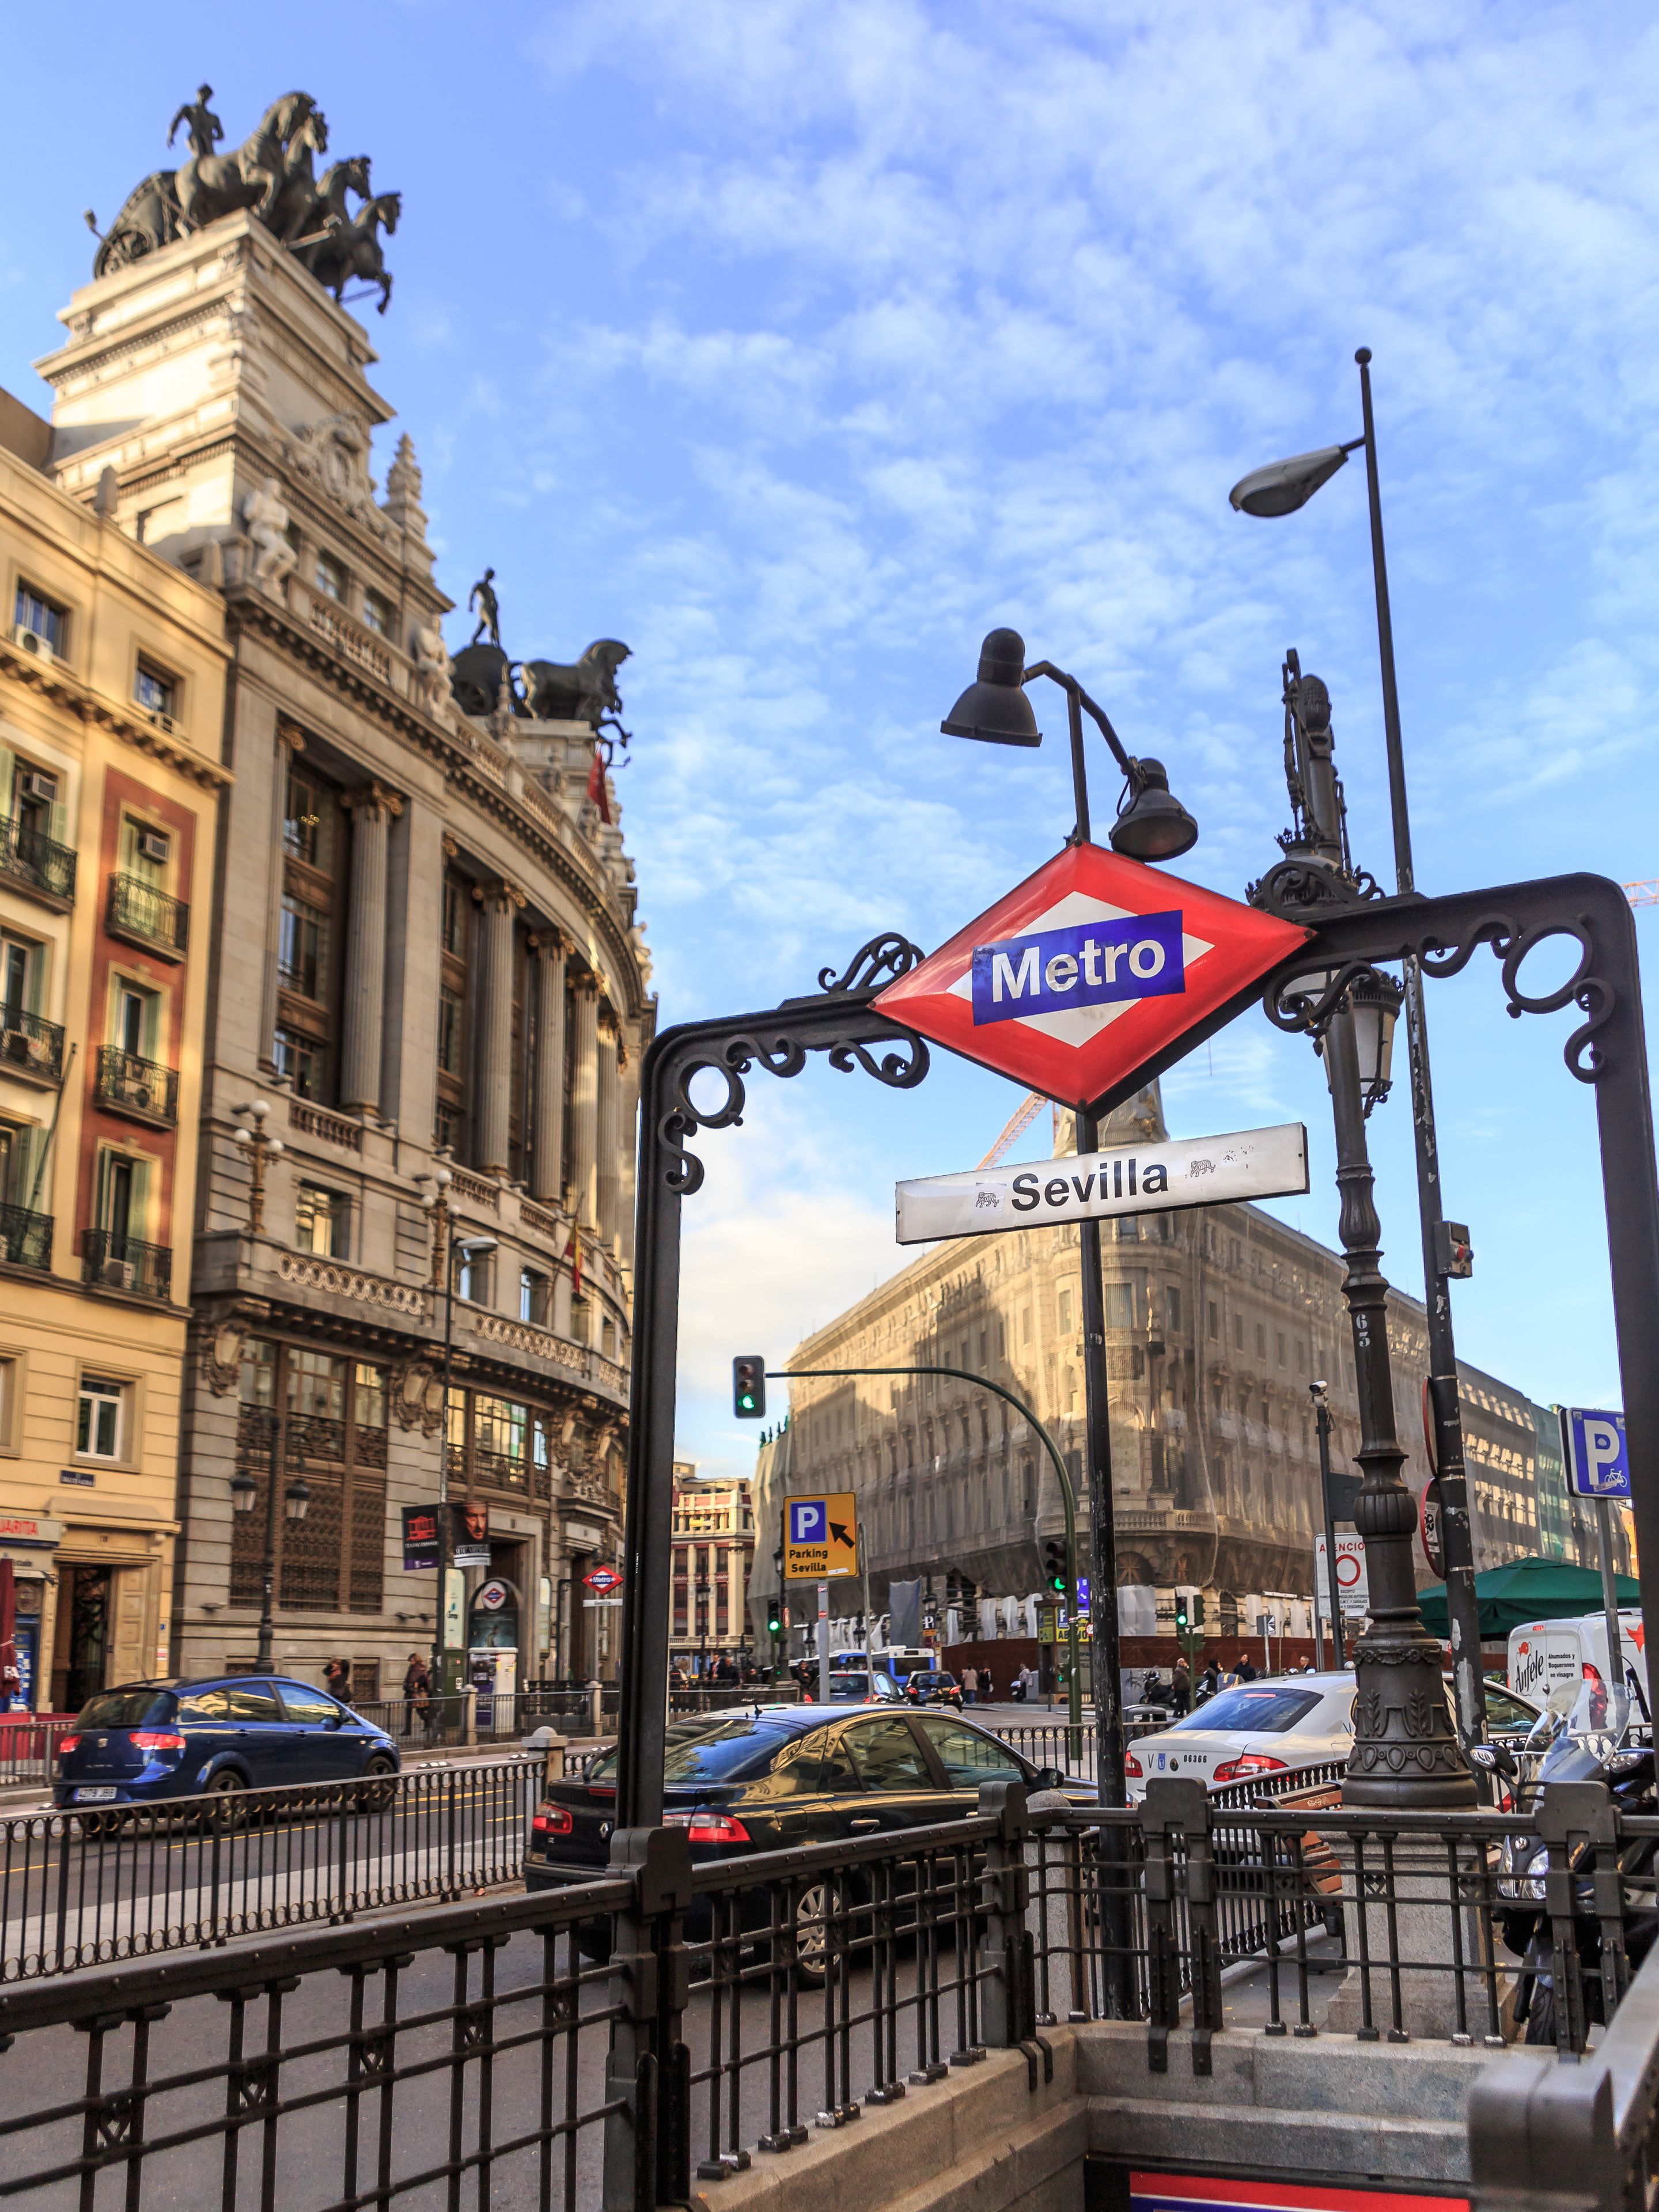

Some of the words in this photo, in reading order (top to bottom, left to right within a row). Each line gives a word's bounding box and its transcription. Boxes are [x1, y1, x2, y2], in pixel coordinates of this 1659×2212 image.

[992, 939, 1165, 1003] Metro
[1011, 1158, 1169, 1212] Sevilla
[1584, 1419, 1620, 1485] P
[797, 1506, 820, 1539] P
[789, 1548, 828, 1559] Parking
[791, 1562, 827, 1573] Sevilla
[1183, 1754, 1207, 1763] 06366
